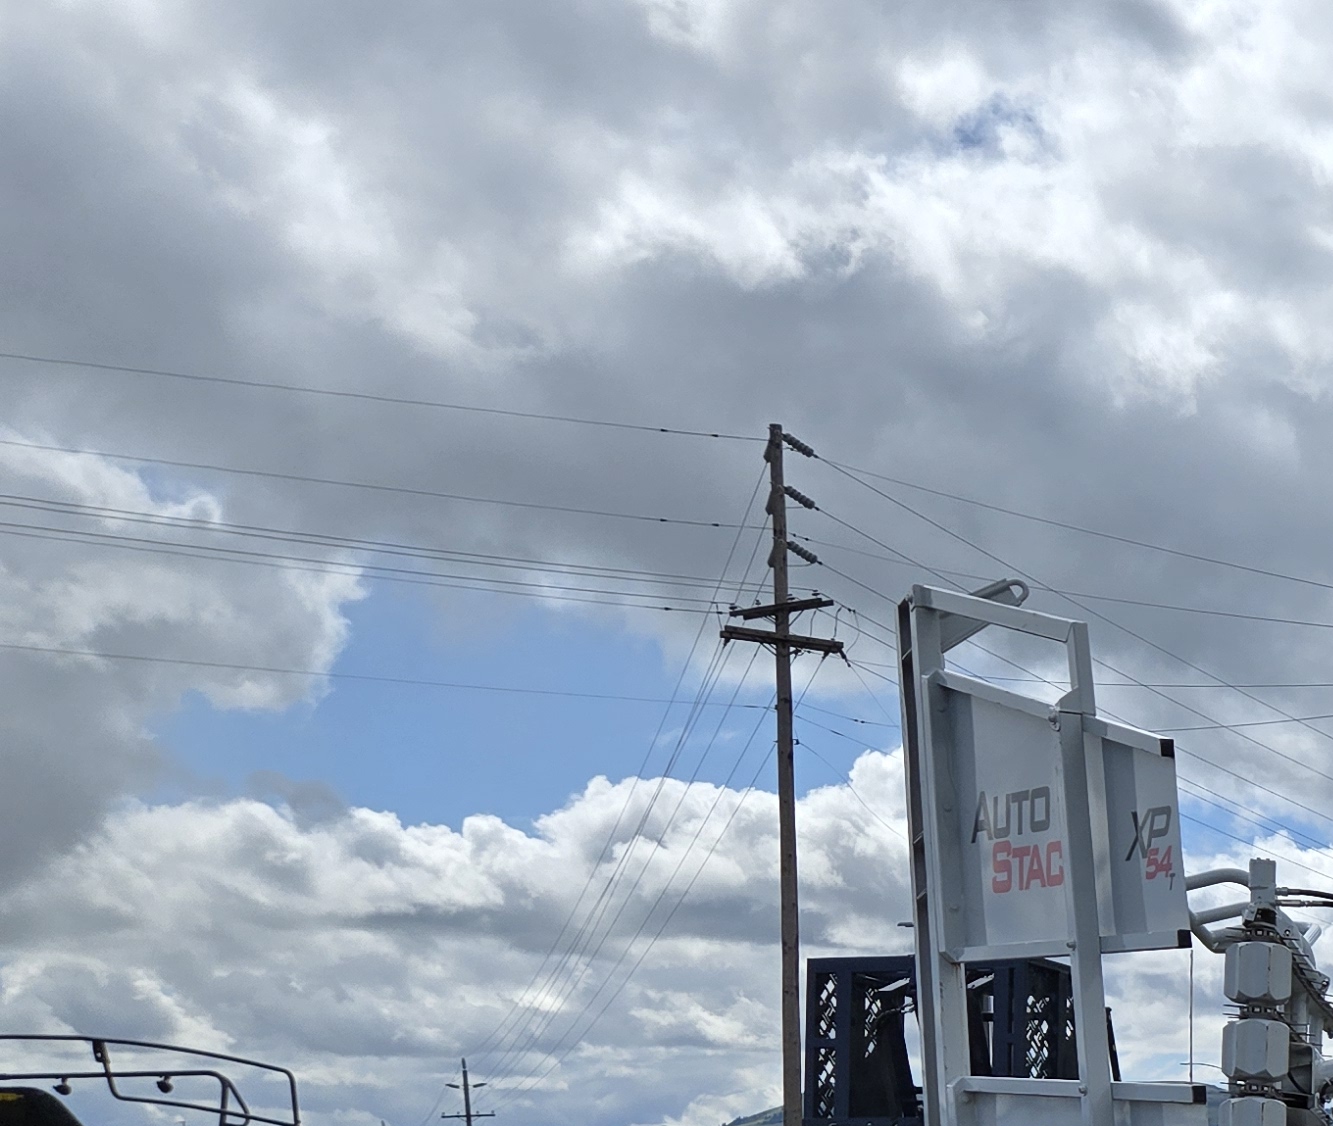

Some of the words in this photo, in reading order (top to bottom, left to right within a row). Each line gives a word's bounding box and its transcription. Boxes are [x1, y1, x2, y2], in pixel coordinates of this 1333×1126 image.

[970, 786, 1050, 844] AUTO
[1125, 805, 1172, 861] XP
[991, 840, 1064, 894] STAC
